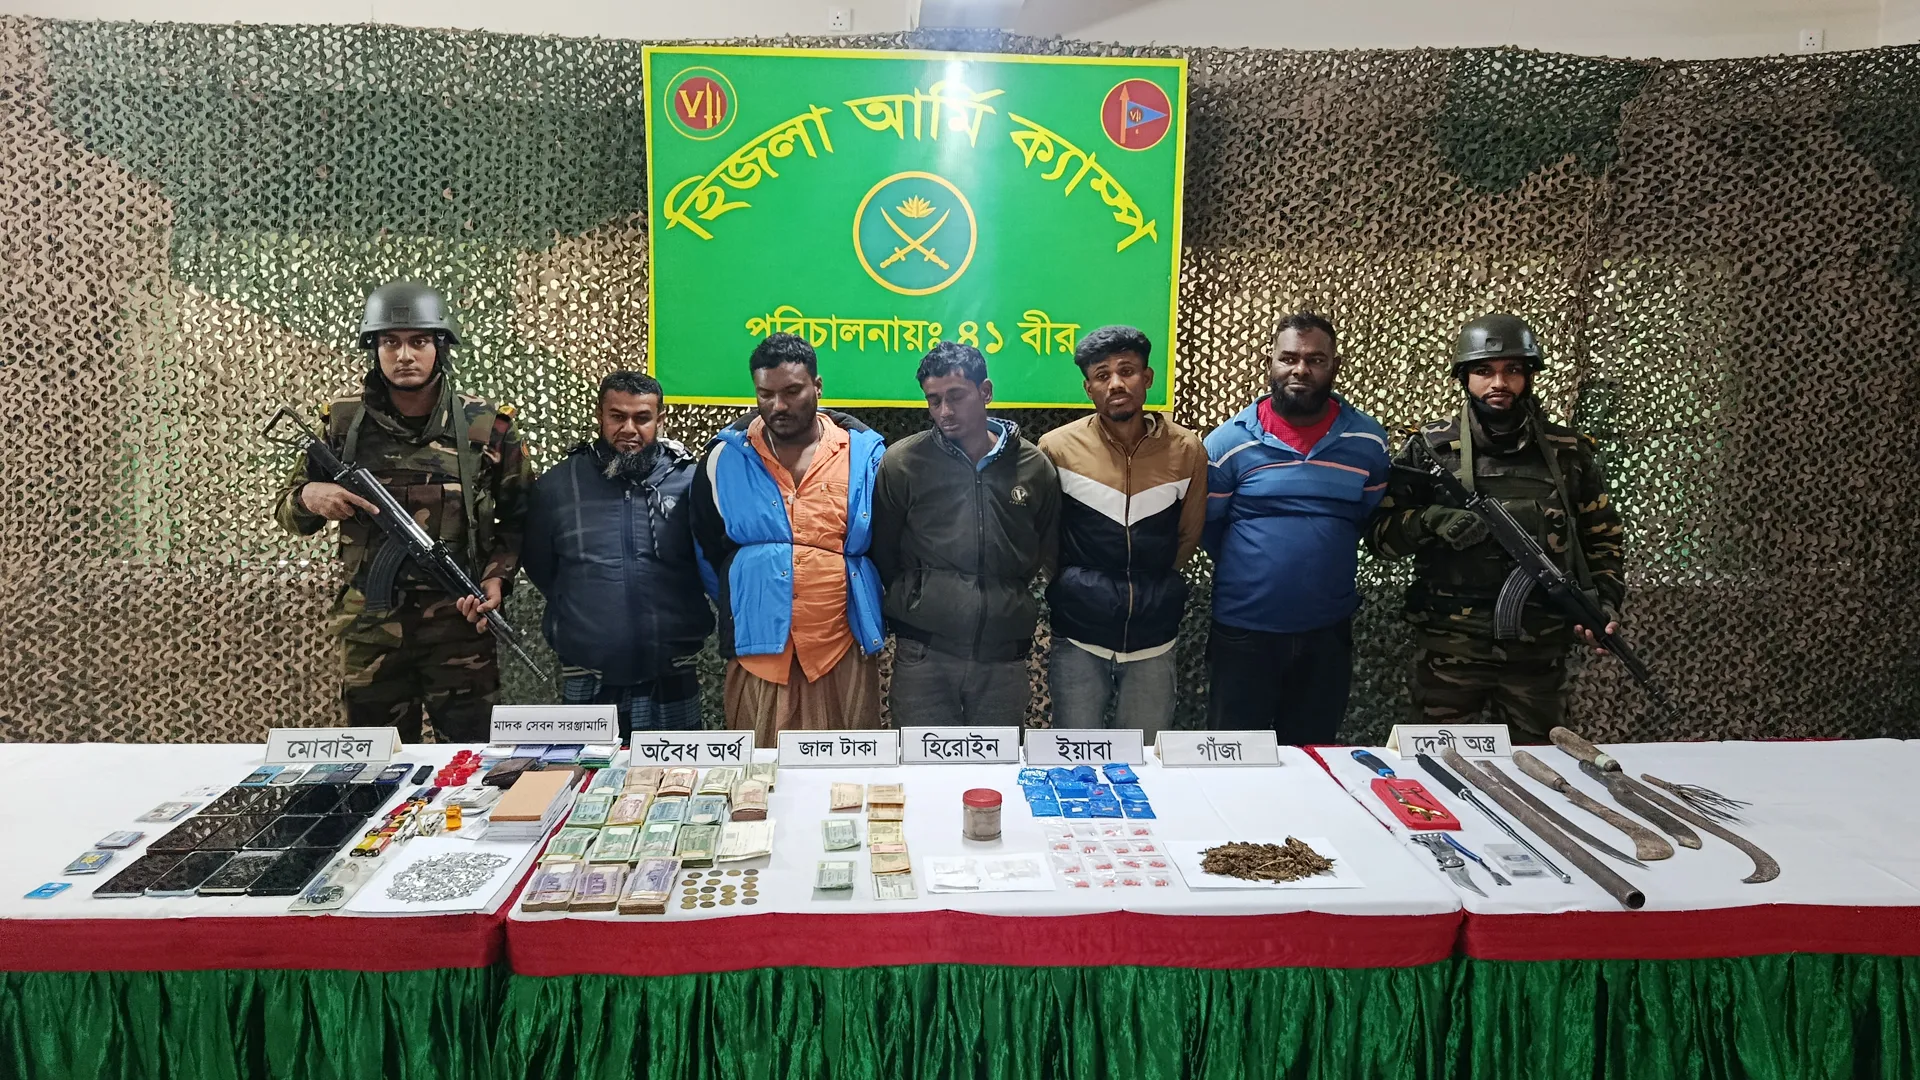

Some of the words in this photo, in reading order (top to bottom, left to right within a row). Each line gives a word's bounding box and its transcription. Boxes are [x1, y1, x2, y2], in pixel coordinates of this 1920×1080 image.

[664, 103, 834, 240] হিজলা
[843, 80, 1006, 147] আর্মি
[1007, 110, 1158, 253] ক্যাম্প
[957, 320, 1004, 355] ৪১
[1016, 309, 1081, 355] বীর
[493, 719, 522, 731] মাদক
[525, 720, 554, 731] সেবন
[557, 717, 608, 732] সরঞ্জামাদি
[287, 737, 374, 759] মোবাইল
[640, 738, 700, 762] অবৈধ
[706, 736, 745, 762] অর্থ
[798, 739, 833, 757] জাল
[839, 737, 878, 757] টাকা
[921, 732, 1000, 760] হিরোইন
[1055, 735, 1113, 762] ইয়াবা
[1197, 736, 1243, 762] গাঁজা
[1411, 729, 1457, 754] দেশী
[1462, 736, 1496, 754] অস্ত্র
